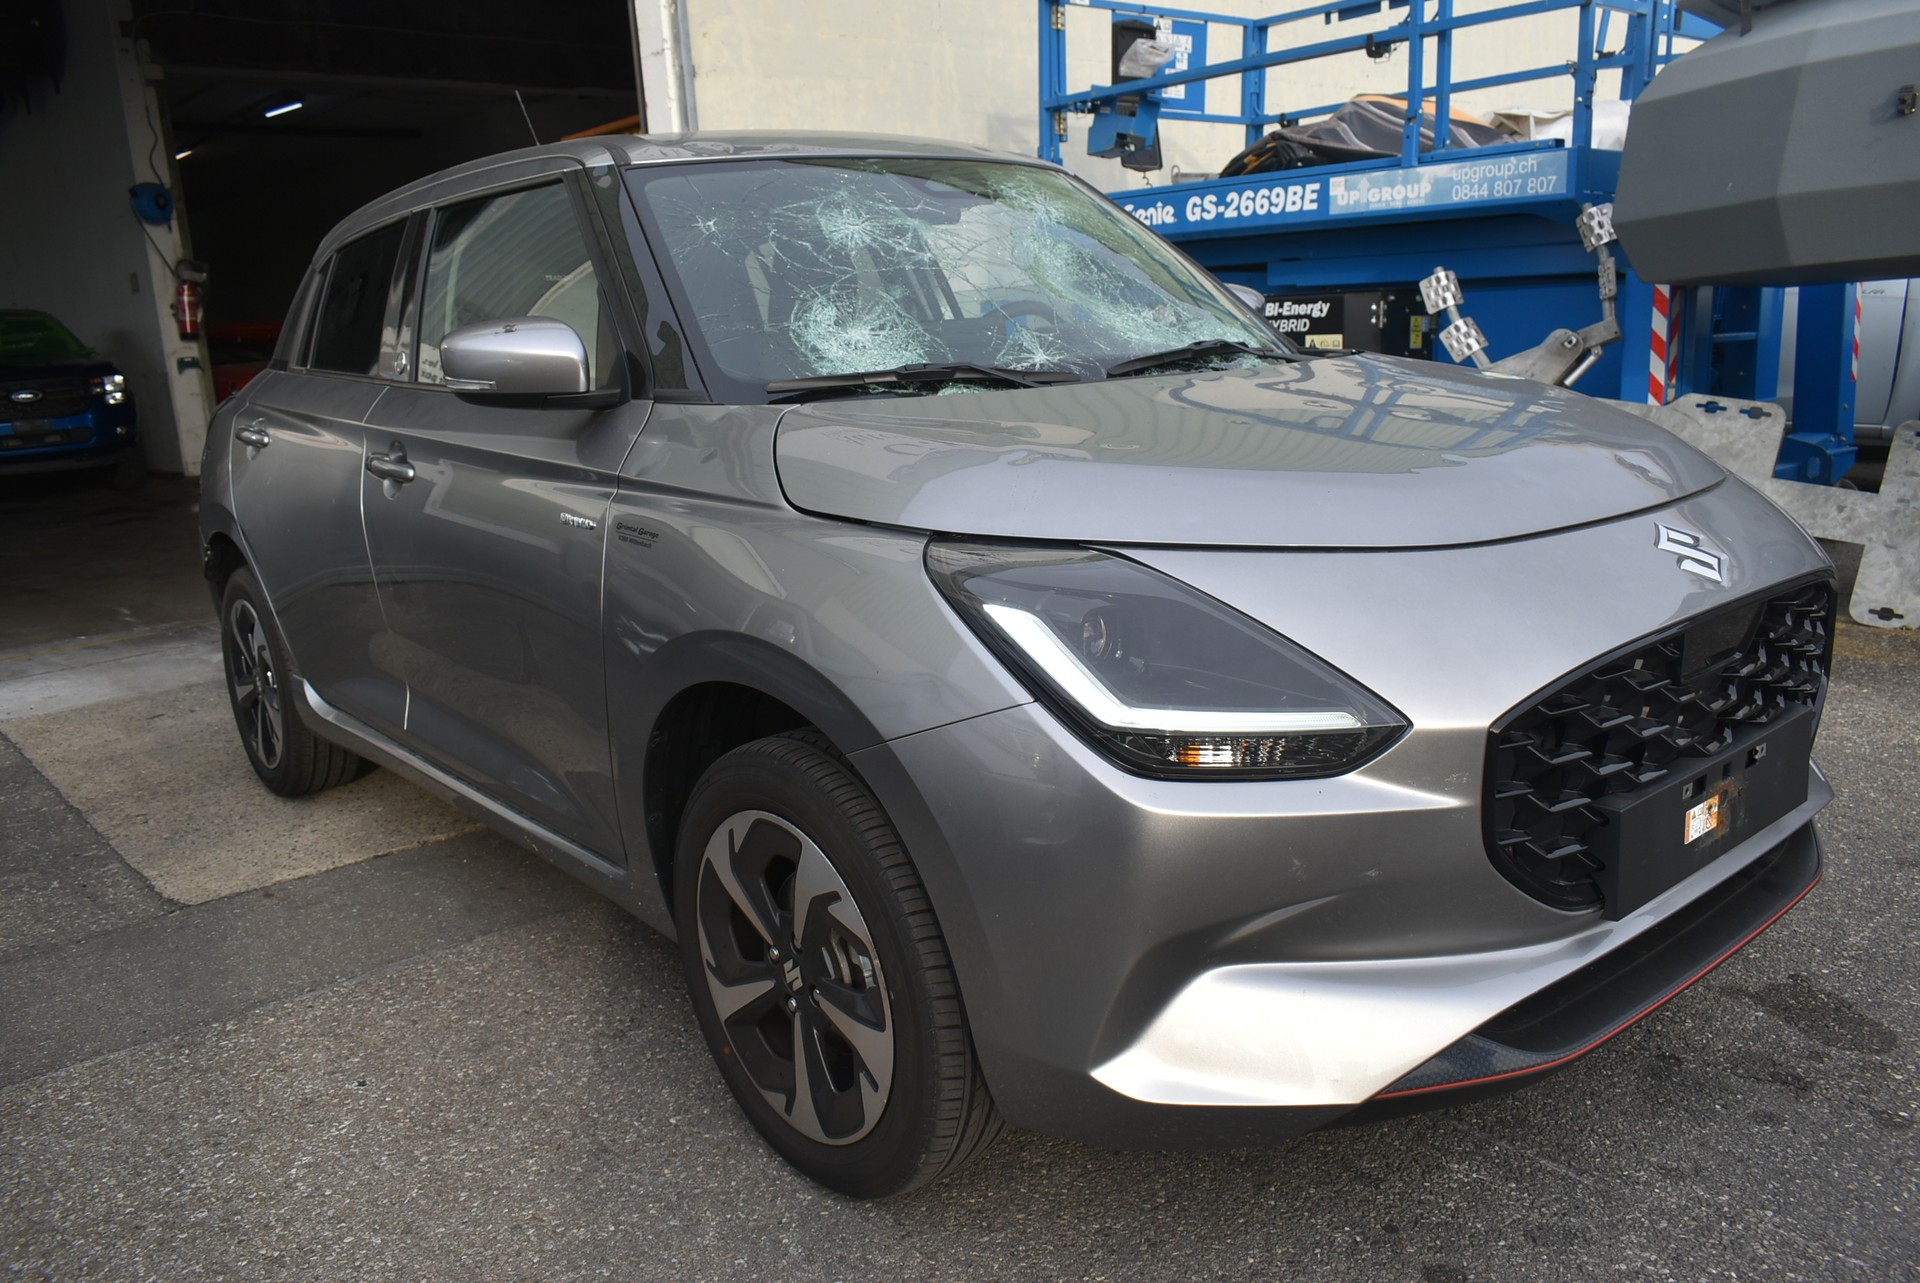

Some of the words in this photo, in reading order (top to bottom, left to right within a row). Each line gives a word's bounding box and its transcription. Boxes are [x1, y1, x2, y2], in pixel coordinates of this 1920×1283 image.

[1452, 157, 1537, 183] upgroup.ch
[1367, 182, 1432, 203] GROUP
[1452, 183, 1488, 200] 0844
[1493, 180, 1522, 197] 807
[1527, 176, 1557, 193] 807
[1186, 182, 1320, 222] GS-2669BE
[1269, 318, 1310, 333] YBRID
